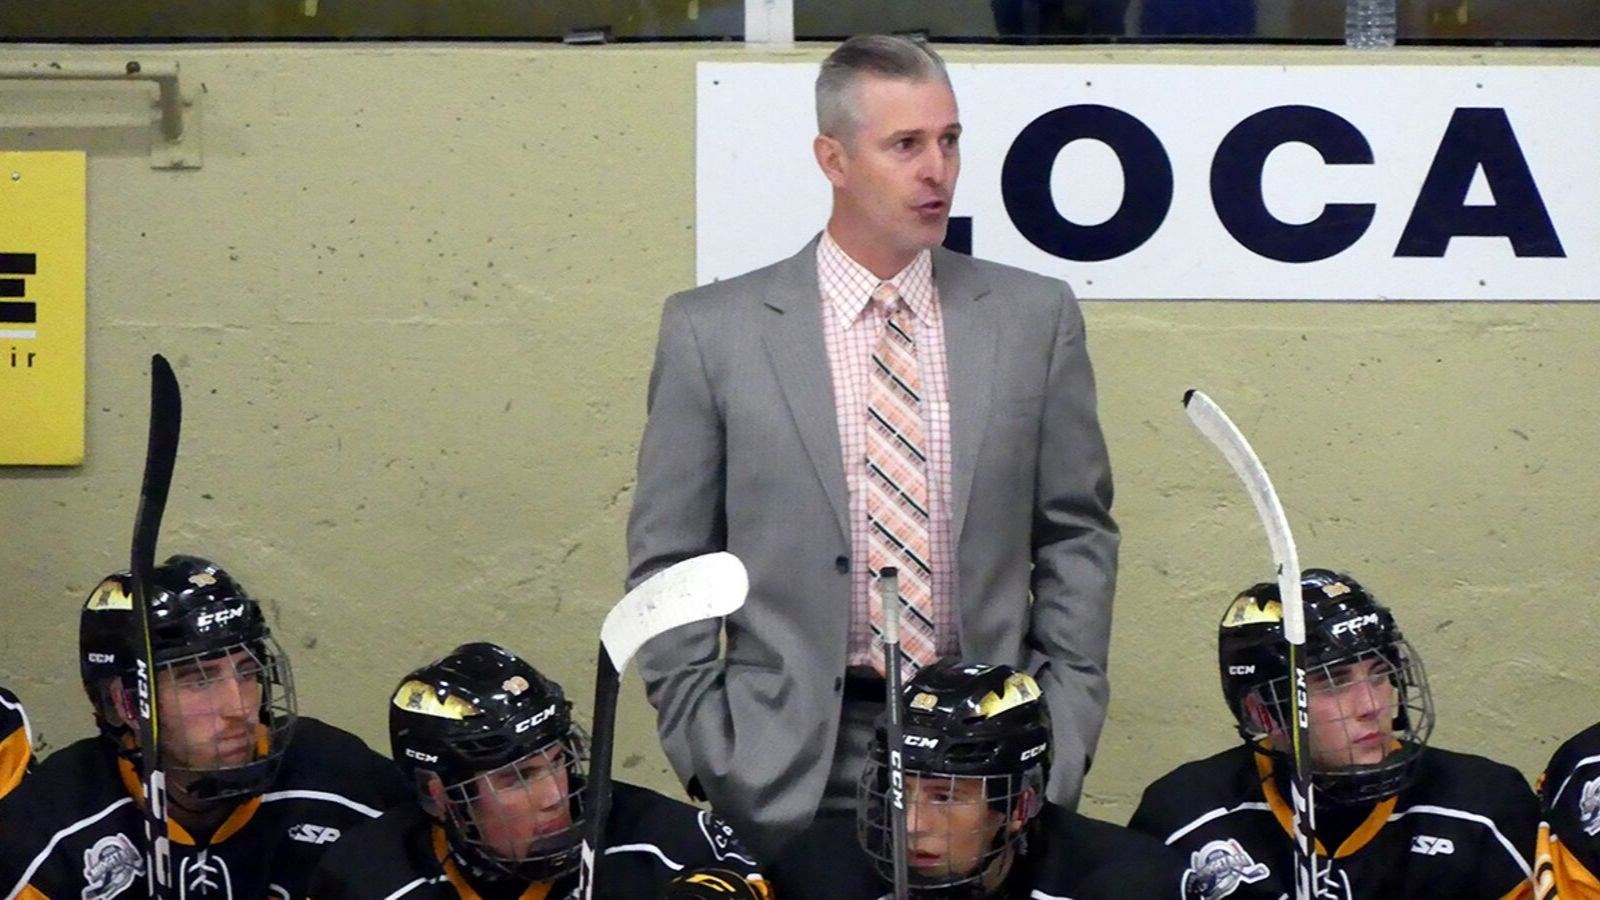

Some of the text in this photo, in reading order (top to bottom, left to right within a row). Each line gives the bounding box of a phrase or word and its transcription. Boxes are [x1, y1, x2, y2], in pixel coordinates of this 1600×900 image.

[943, 104, 1566, 263] OCA
[197, 604, 244, 628] CCM
[1331, 612, 1379, 636] CCM
[88, 653, 115, 663] CCM
[1228, 664, 1256, 676] CCM
[137, 659, 151, 719] CCM
[1296, 668, 1309, 729] CCM
[515, 704, 557, 734] CCM
[902, 734, 939, 749] CM
[1019, 742, 1047, 762] CCM
[405, 748, 438, 764] CCM
[890, 750, 904, 810] CCM
